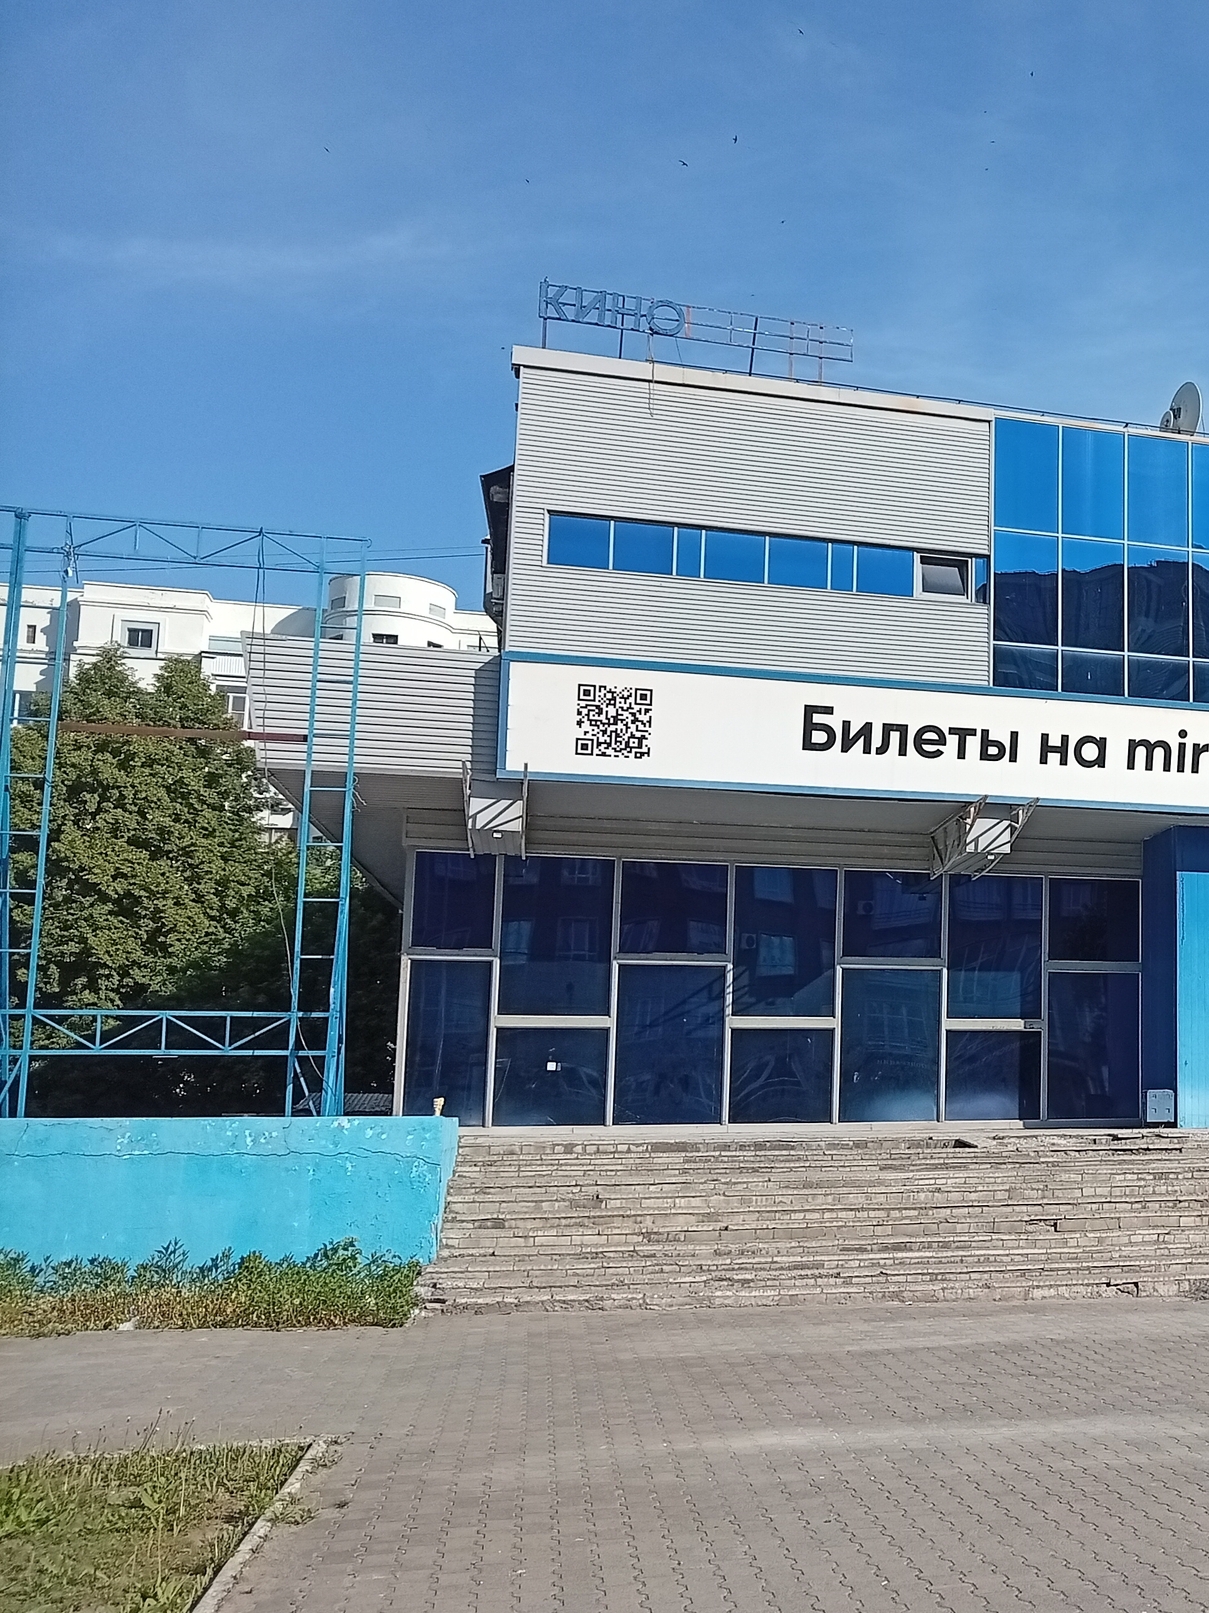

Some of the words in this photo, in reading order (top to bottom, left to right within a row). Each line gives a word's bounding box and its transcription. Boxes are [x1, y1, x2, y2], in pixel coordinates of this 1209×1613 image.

[539, 281, 686, 337] КИНО
[801, 704, 1019, 763] Билеты
[1039, 732, 1107, 769] на
